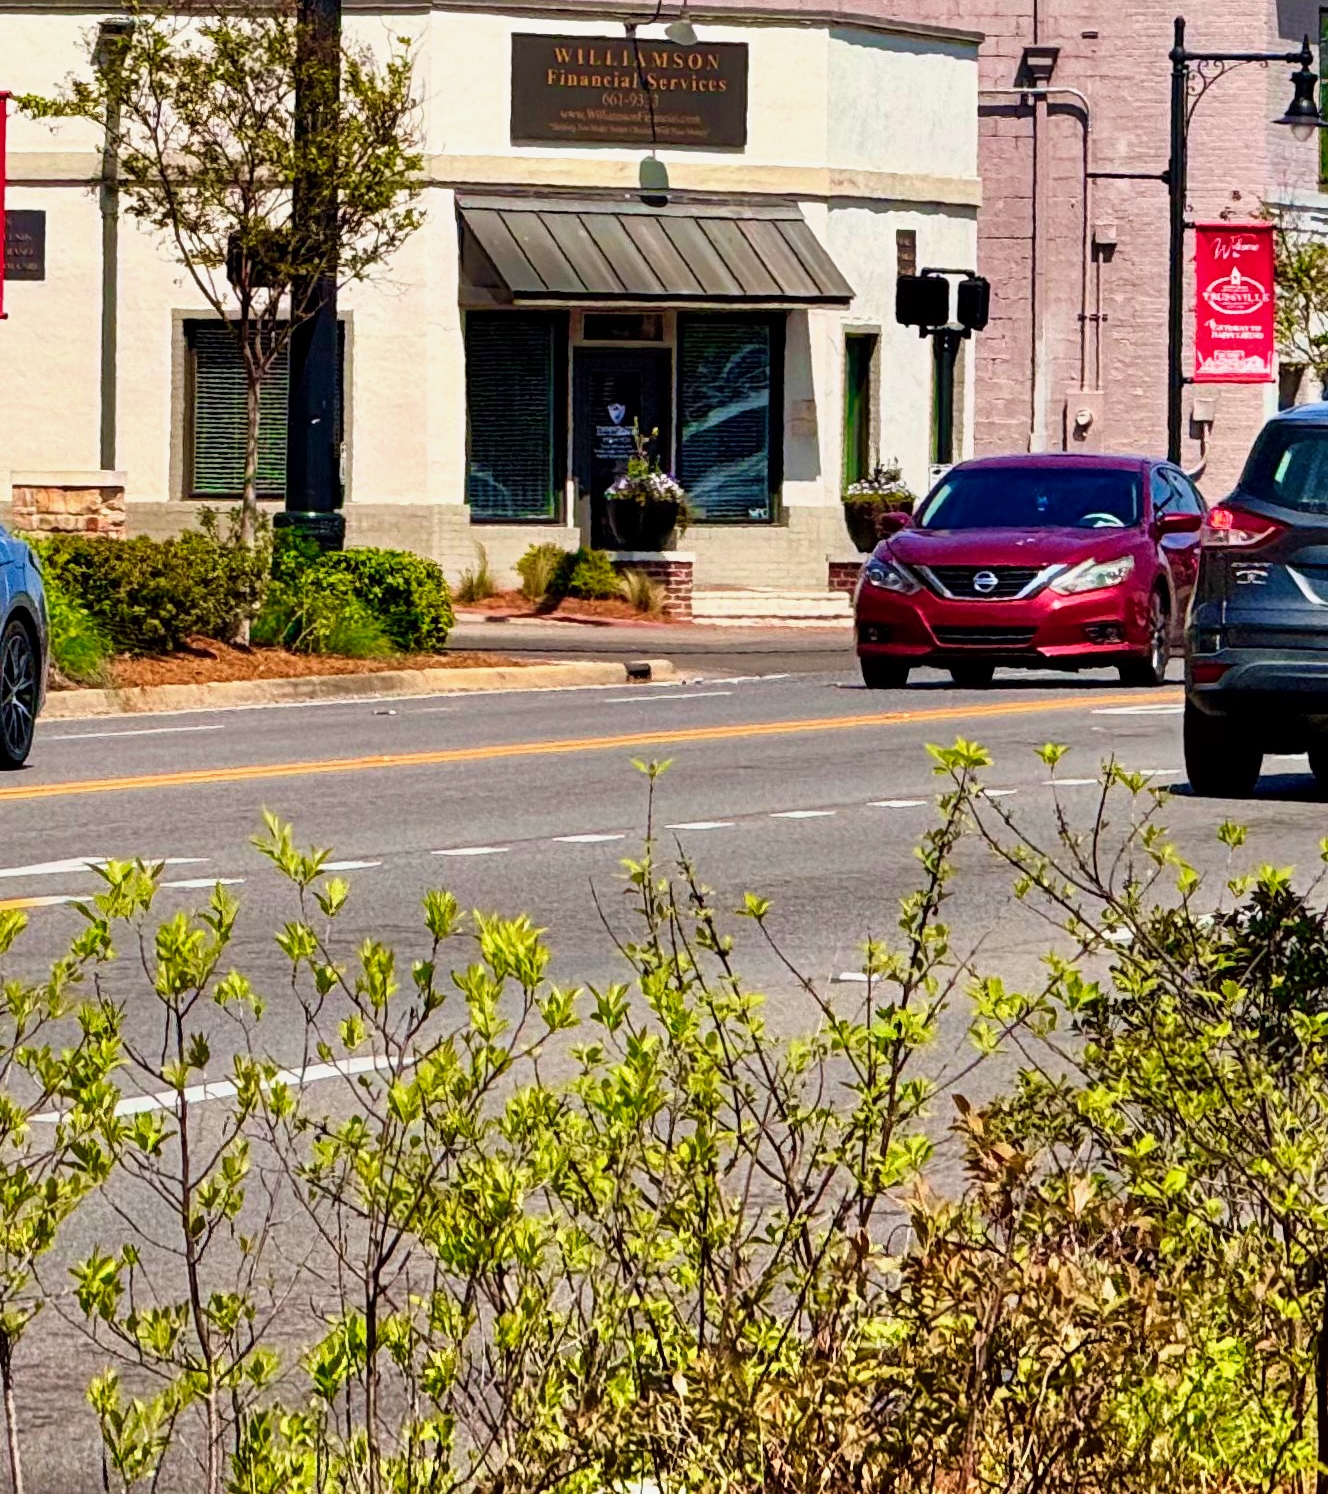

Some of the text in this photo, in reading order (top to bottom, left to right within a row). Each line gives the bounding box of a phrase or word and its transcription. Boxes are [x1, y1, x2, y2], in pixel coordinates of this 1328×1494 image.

[554, 48, 720, 69] WILLIAMSON
[547, 68, 727, 93] Financial Services
